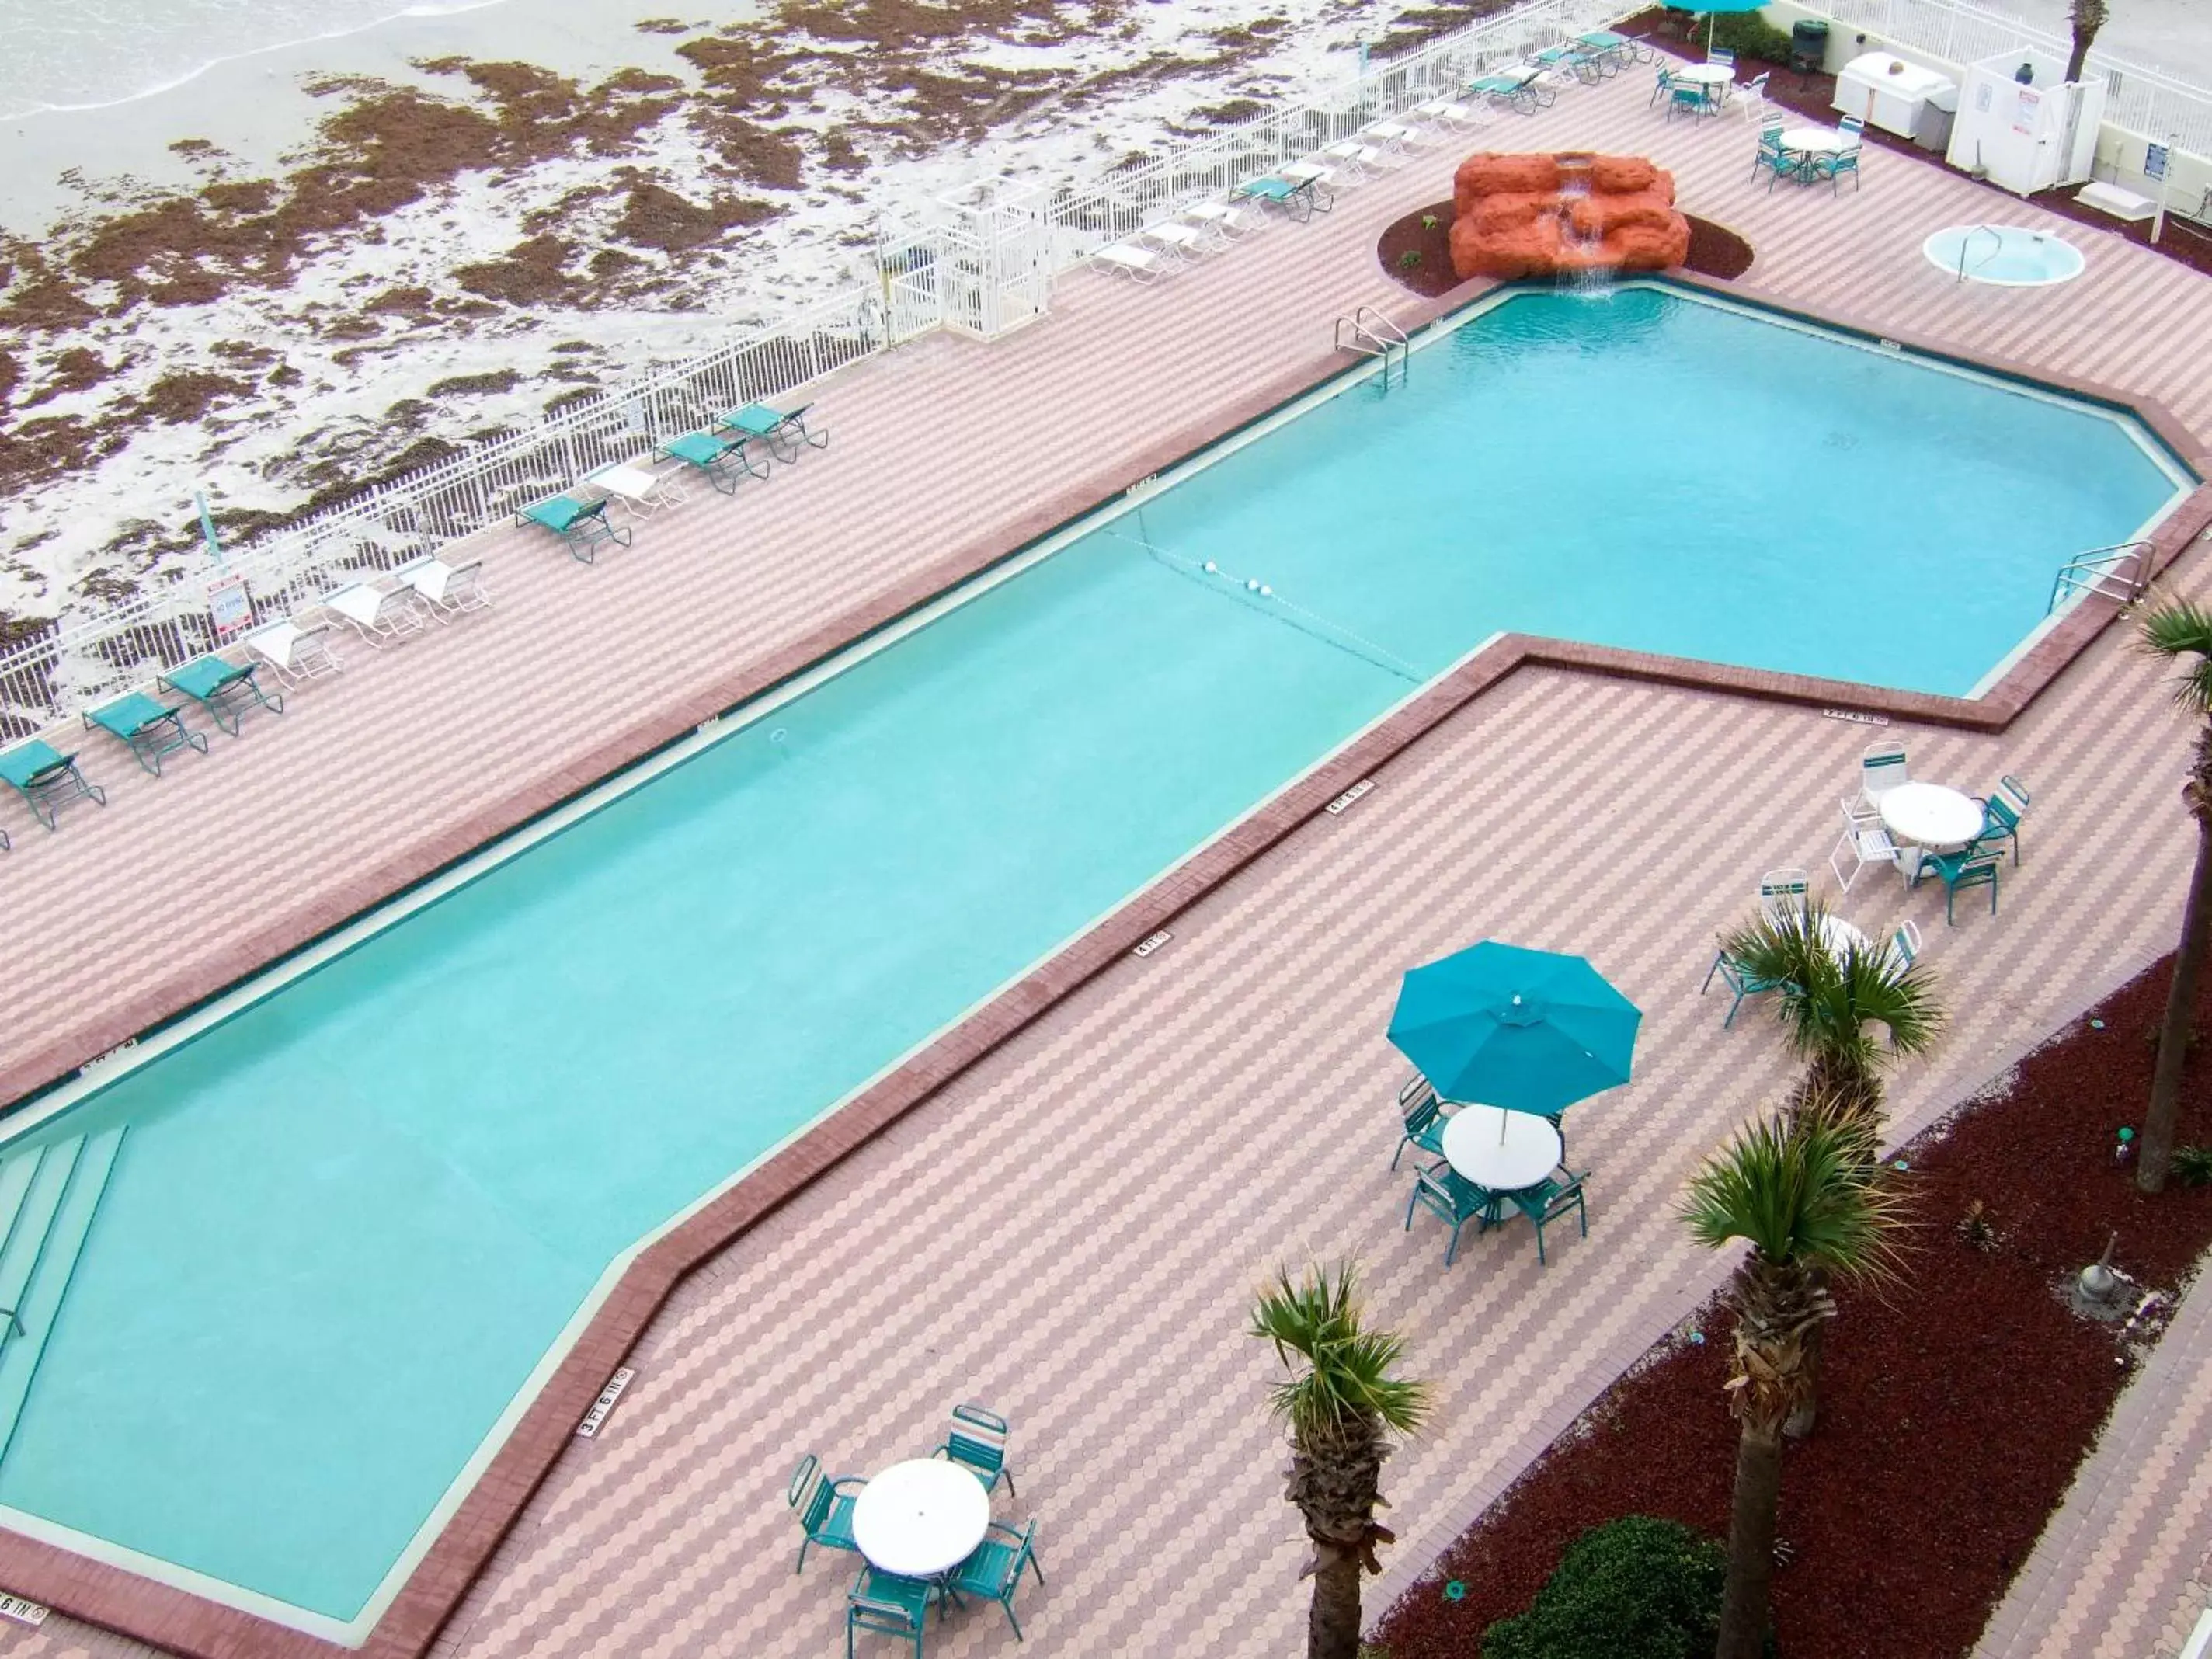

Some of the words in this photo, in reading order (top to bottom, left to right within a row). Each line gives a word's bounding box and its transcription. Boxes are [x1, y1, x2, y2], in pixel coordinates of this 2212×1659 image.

[581, 1423, 593, 1431] 3
[588, 1407, 604, 1421] FT
[599, 1396, 611, 1405] 6
[606, 1382, 622, 1395] IN
[1, 1598, 12, 1609] 6
[12, 1602, 31, 1616] IN
